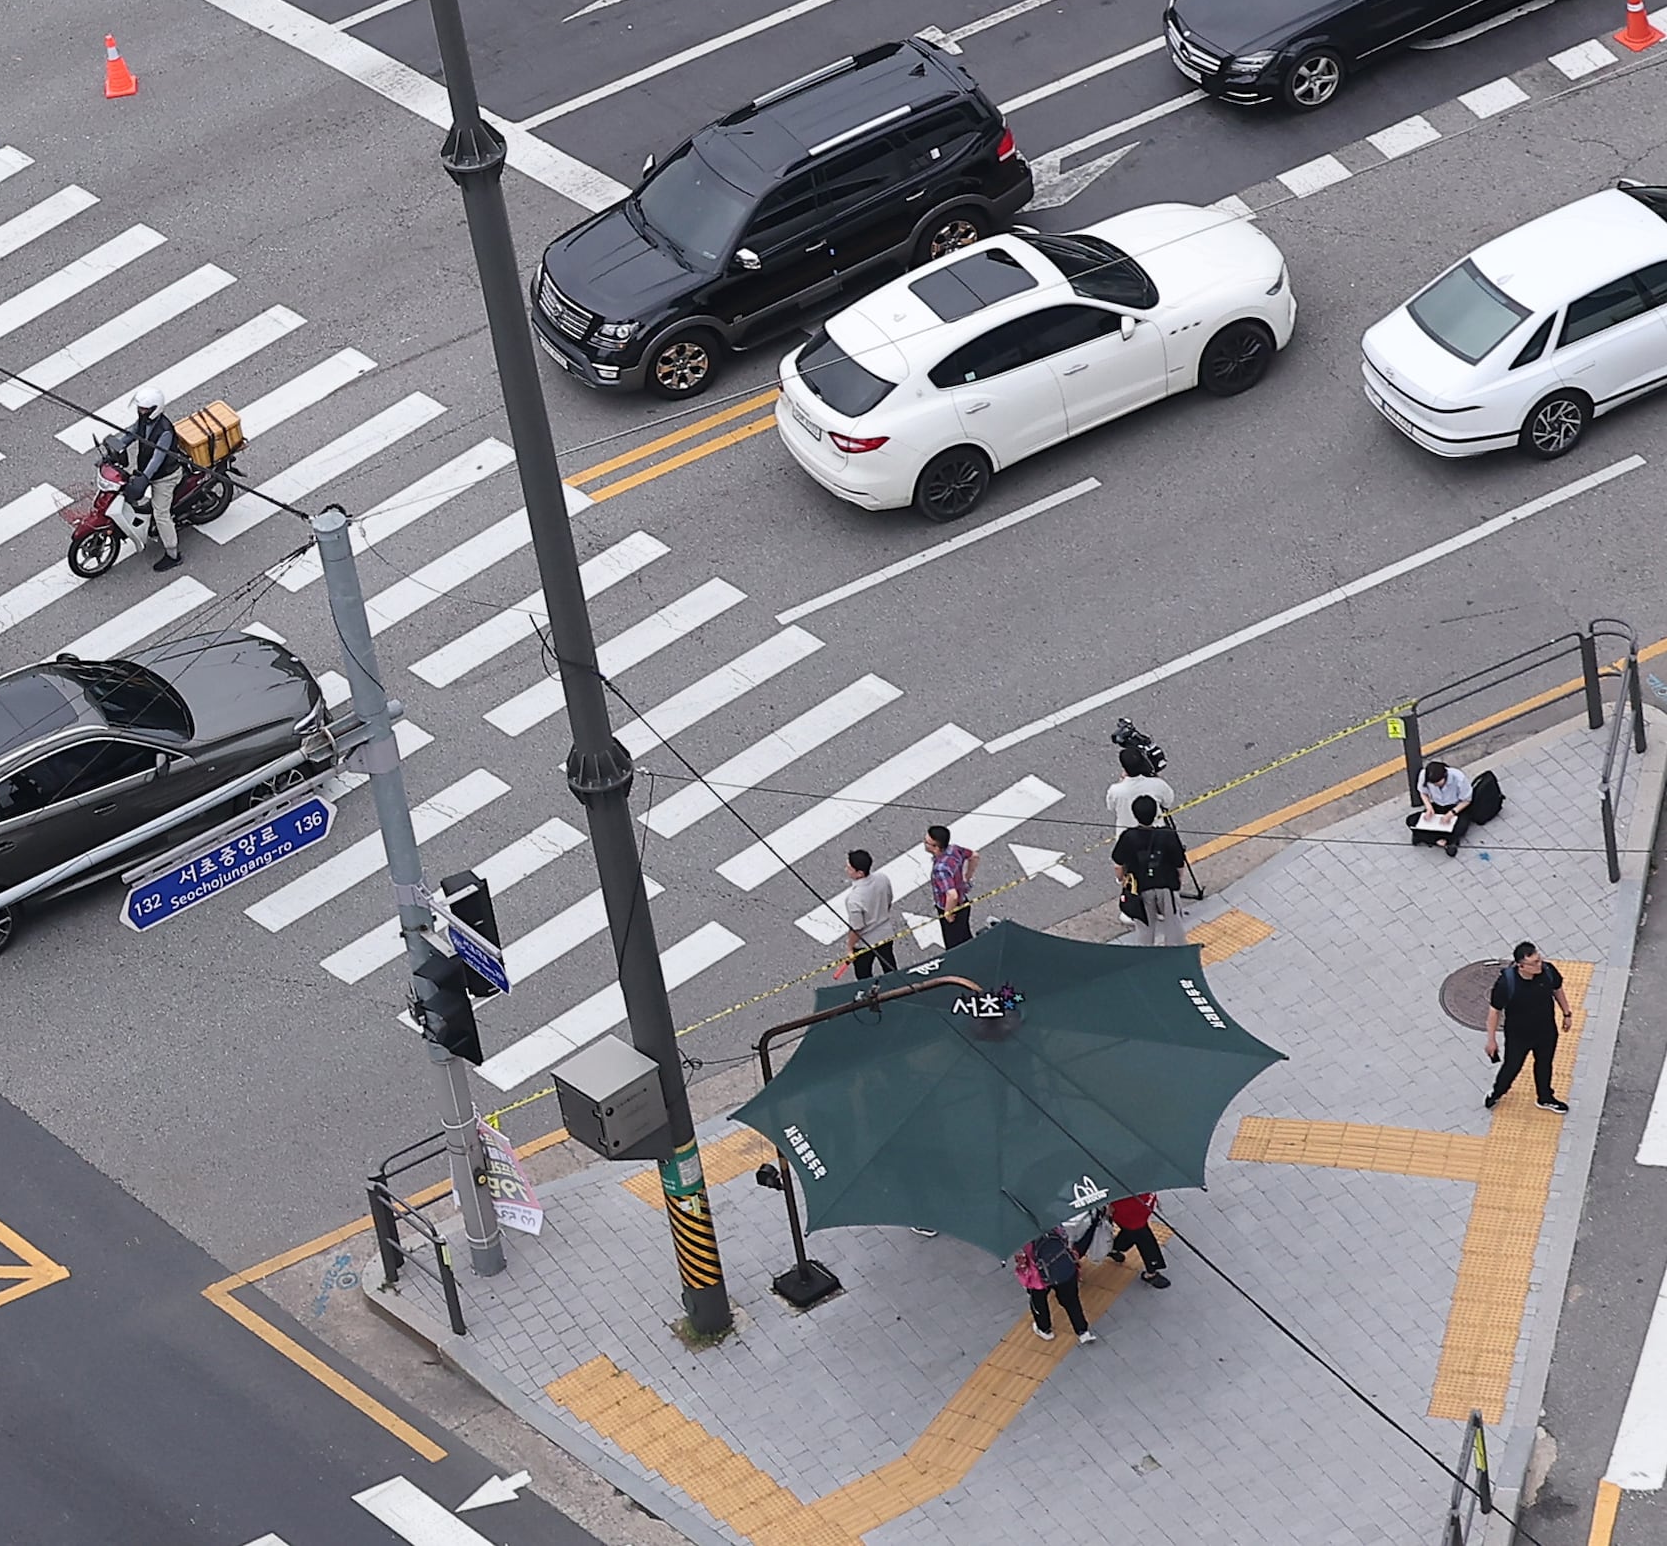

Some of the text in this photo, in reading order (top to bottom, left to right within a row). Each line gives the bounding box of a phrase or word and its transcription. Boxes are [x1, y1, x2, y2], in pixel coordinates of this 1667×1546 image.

[133, 810, 323, 918] 132 Seochojungang-ro 136
[178, 825, 280, 886] 서초중앙로
[952, 993, 1005, 1019] 서초
[783, 1125, 828, 1180] 서리풀원두막
